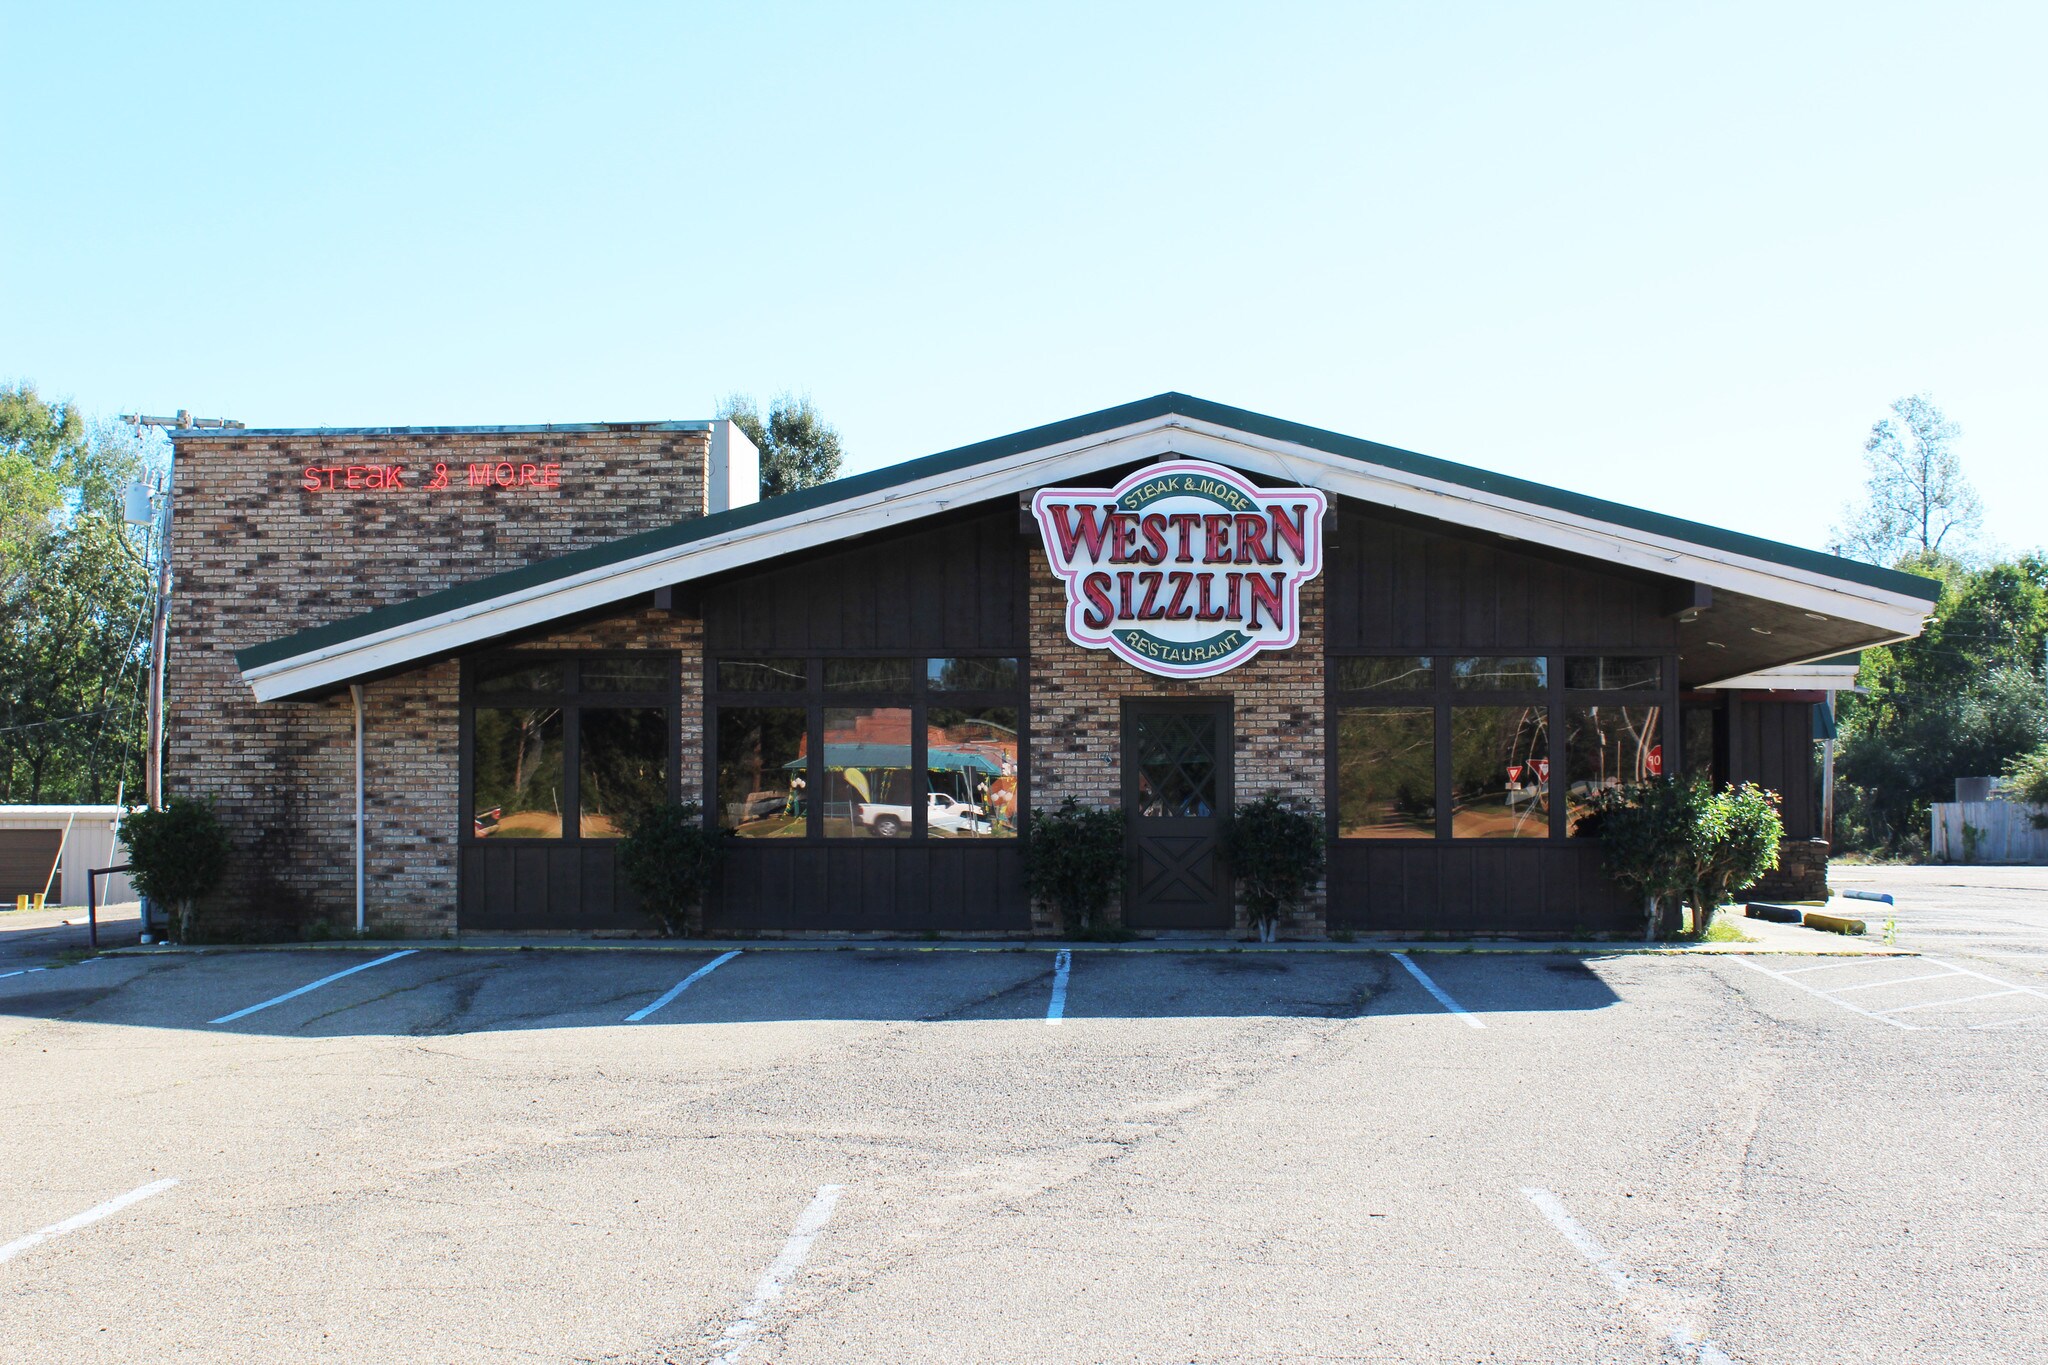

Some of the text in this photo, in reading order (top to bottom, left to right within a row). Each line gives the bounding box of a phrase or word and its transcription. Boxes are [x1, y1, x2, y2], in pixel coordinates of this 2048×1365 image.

[422, 462, 449, 489] &
[469, 462, 559, 487] MORE
[1124, 477, 1250, 511] STEAK & MORE
[1047, 504, 1309, 566] WESTERN
[1083, 571, 1288, 632] SIZZLIN
[1124, 631, 1239, 662] RESTAURANT
